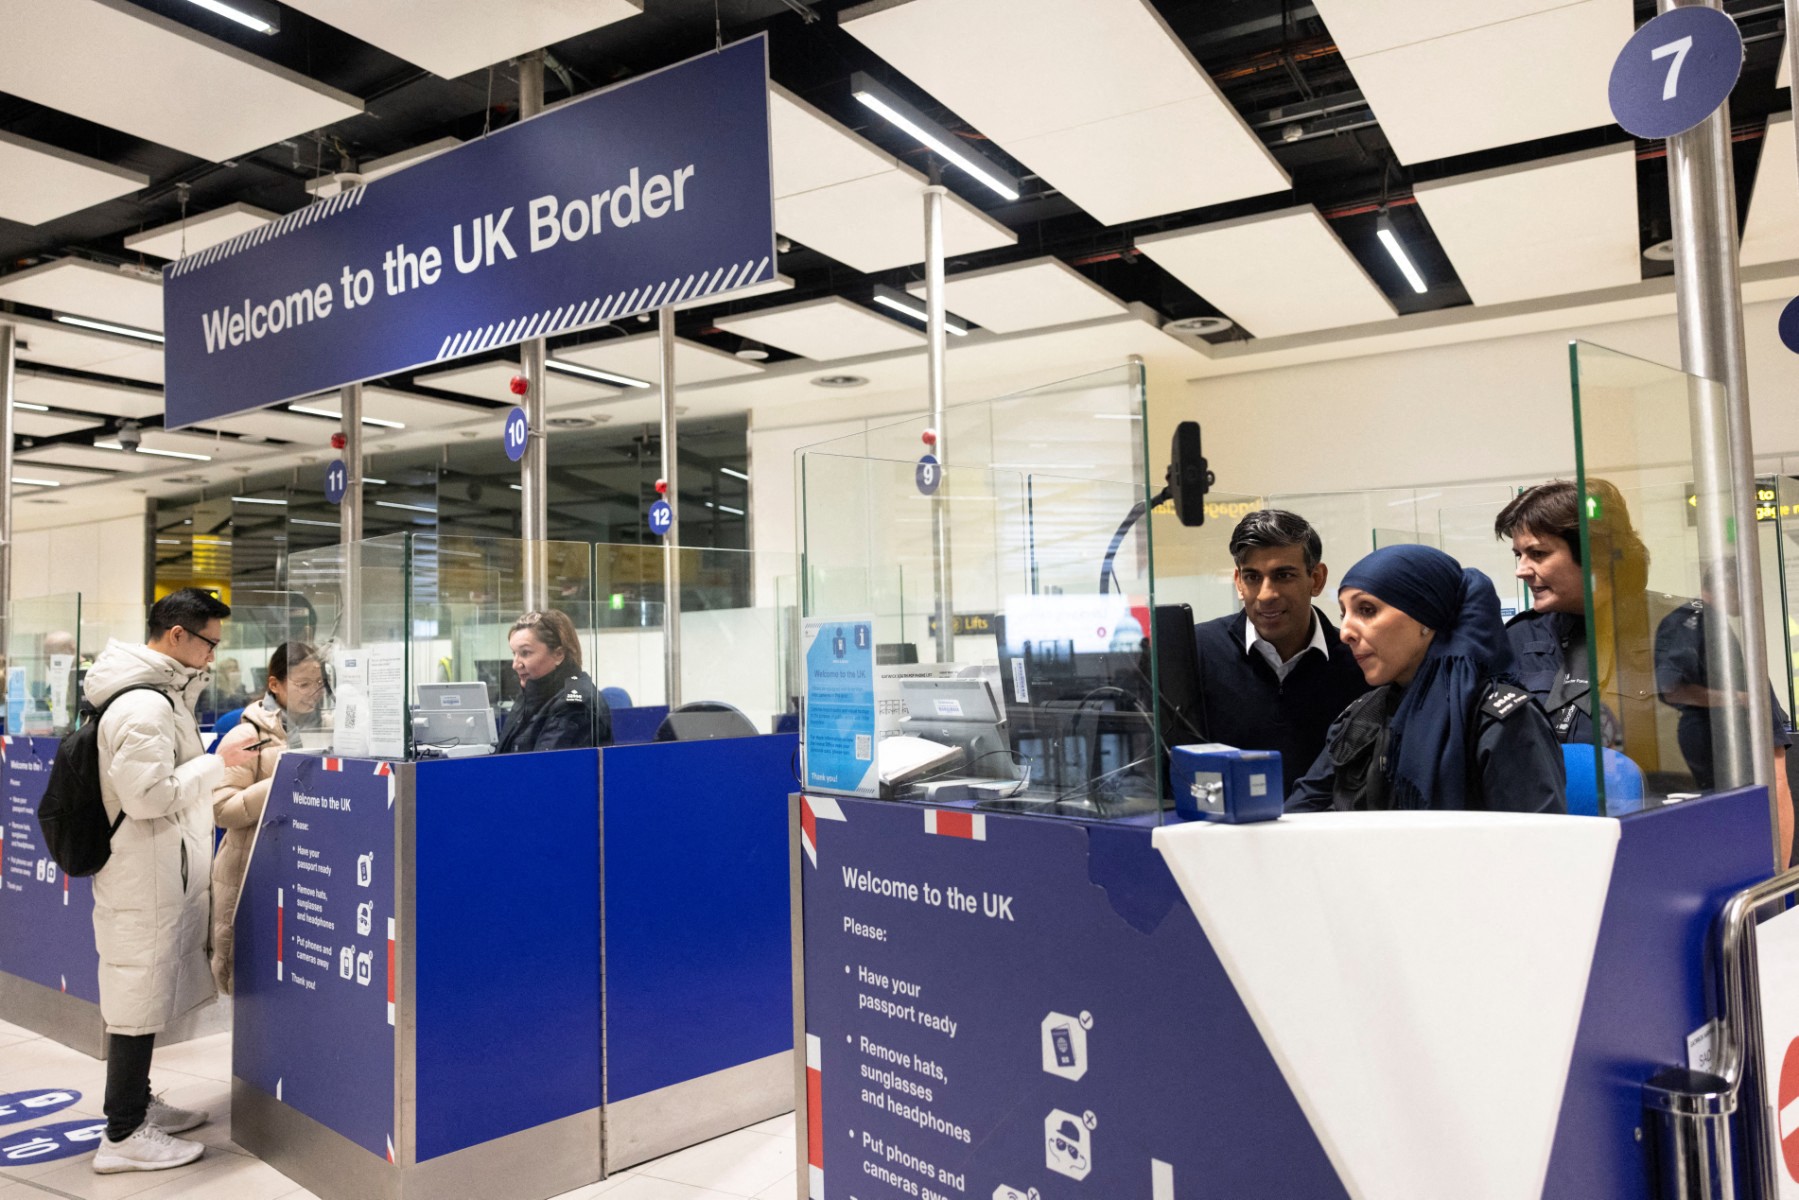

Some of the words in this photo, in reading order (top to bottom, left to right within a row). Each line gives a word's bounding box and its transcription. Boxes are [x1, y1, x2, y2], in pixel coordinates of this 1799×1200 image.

[1651, 35, 1693, 101] 7
[202, 282, 333, 354] Welcome
[340, 265, 374, 309] to
[382, 244, 442, 296] the
[453, 207, 518, 276] UK
[529, 164, 695, 253] Border
[508, 419, 525, 445] 10
[329, 470, 345, 493] 11
[923, 464, 934, 485] 9
[1757, 489, 1775, 501] to
[652, 509, 670, 527] 12
[965, 617, 988, 629] Lifts
[814, 669, 838, 678] Welcome
[840, 669, 846, 678] to
[847, 669, 856, 678] the
[858, 669, 866, 678] UK
[293, 791, 320, 806] Welcome
[321, 797, 328, 808] to
[329, 797, 339, 809] the
[340, 799, 351, 811] UK
[293, 819, 308, 830] Please:
[297, 845, 309, 857] Have
[309, 849, 320, 858] your
[297, 860, 318, 871] passport
[319, 865, 331, 877] ready
[297, 883, 316, 896] Remove
[316, 888, 327, 901] hats,
[842, 866, 919, 902] Welcome
[923, 882, 942, 906] to
[946, 887, 978, 914] the
[983, 893, 1014, 921] UK
[297, 899, 322, 913] sunglasses
[297, 912, 306, 922] and
[306, 914, 334, 930] headphones
[844, 916, 887, 942] Please:
[305, 938, 322, 953] phones
[321, 945, 332, 957] and
[297, 951, 316, 964] cameras
[316, 957, 329, 970] away
[291, 972, 305, 987] Thank
[305, 978, 316, 991] you!
[858, 965, 888, 989] Have
[891, 978, 921, 999] your
[858, 993, 914, 1024] passport
[918, 1008, 957, 1038] ready
[860, 1036, 911, 1068] Remove
[914, 1055, 948, 1083] hats,
[860, 1063, 933, 1101] sunglasses
[861, 1086, 884, 1108] and
[888, 1095, 971, 1143] headphones
[1, 1137, 60, 1160] 10
[862, 1131, 883, 1155] Put
[886, 1148, 935, 1178] phones
[938, 1165, 965, 1192] and
[863, 1160, 918, 1197] cameras
[921, 1187, 950, 1200] aw
